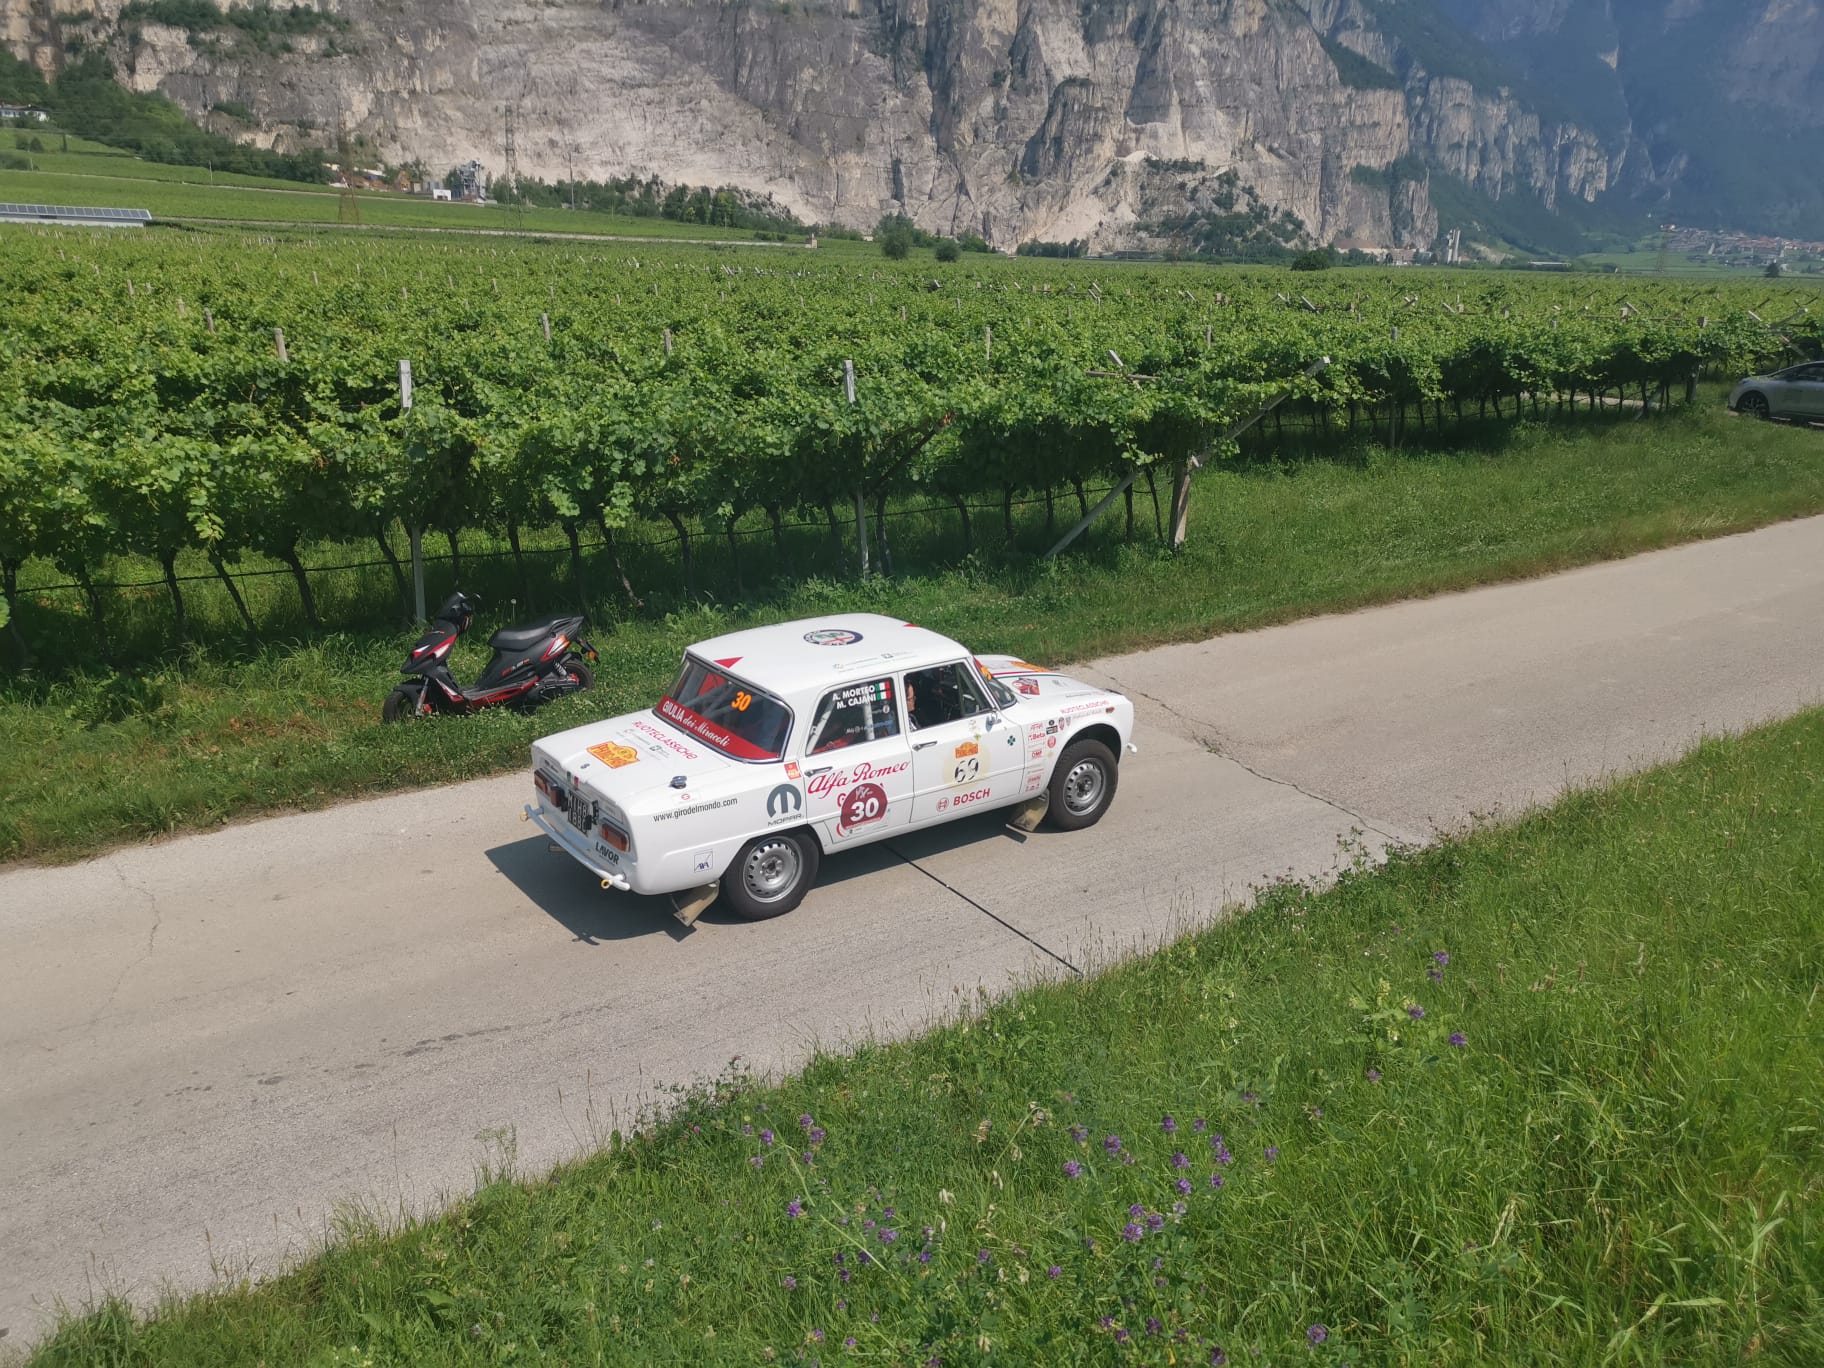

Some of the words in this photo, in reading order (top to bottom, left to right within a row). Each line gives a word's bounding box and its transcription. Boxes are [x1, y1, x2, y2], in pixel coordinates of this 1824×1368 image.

[731, 691, 752, 711] 30
[837, 701, 846, 710] M.
[848, 693, 876, 707] CAJANI
[842, 685, 875, 700] MORTEO
[662, 701, 685, 722] GIULIA
[683, 714, 695, 729] dei
[807, 770, 848, 799] Alfa
[851, 762, 911, 783] Romeo
[953, 788, 991, 806] BOSCH
[653, 797, 738, 823] www.girodelmondo.com
[767, 813, 802, 827] MOPAR
[850, 797, 880, 822] 30
[595, 841, 620, 865] LAVOR
